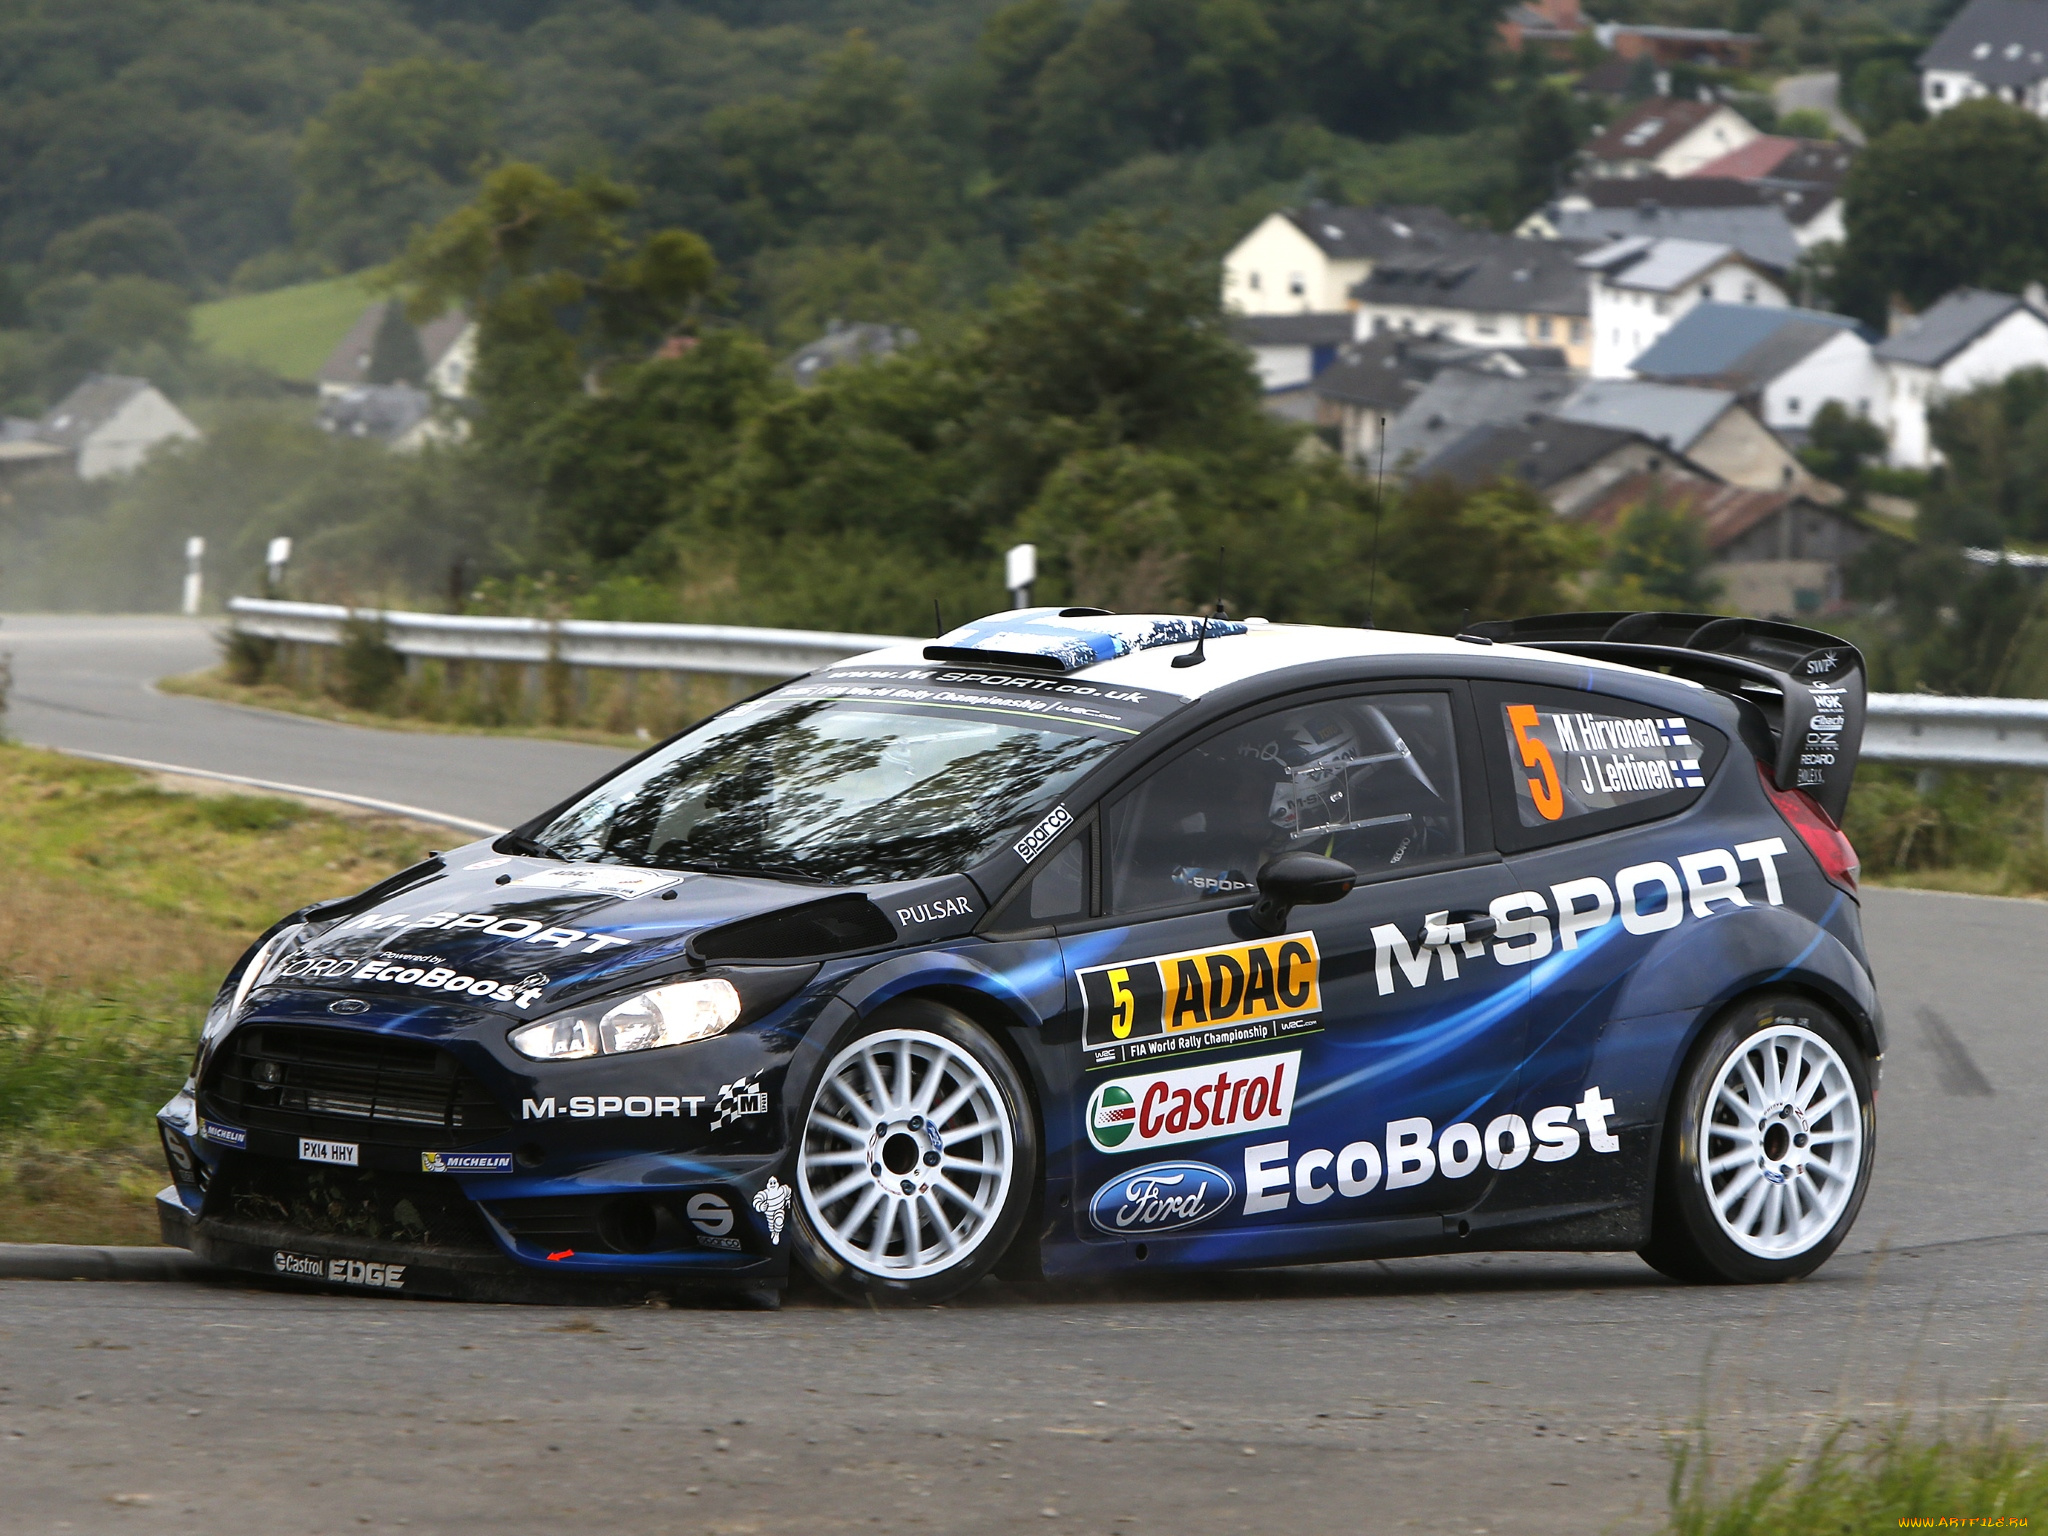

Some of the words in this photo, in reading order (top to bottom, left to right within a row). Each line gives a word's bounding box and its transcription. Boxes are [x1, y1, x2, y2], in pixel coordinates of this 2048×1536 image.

[932, 691, 1049, 712] Championship
[1812, 694, 1843, 708] NGK
[1552, 713, 1580, 752] M
[1574, 712, 1662, 751] Hirvonen
[1505, 704, 1565, 821] 5
[1579, 755, 1595, 795] J
[1591, 752, 1676, 793] Lehtinen
[1800, 753, 1836, 765] RECARO
[1017, 808, 1069, 856] sparco
[896, 896, 974, 926] PULSAR
[1369, 837, 1789, 996] M-SPORT
[340, 912, 633, 955] M-SPORT
[380, 950, 428, 964] Powered
[429, 953, 447, 965] by
[350, 959, 544, 1011] EcoBoost
[1107, 967, 1135, 1040] 5
[1172, 941, 1312, 1028] ADAC
[1130, 1044, 1148, 1058] FIA
[1148, 1038, 1177, 1055] World
[1178, 1035, 1202, 1050] Rally
[1203, 1025, 1269, 1046] Championship
[521, 1095, 707, 1120] M-SPORT
[1138, 1063, 1284, 1140] Castrol
[207, 1125, 246, 1143] MICHELIN
[303, 1142, 328, 1159] PX14
[331, 1145, 354, 1162] HHY
[1242, 1086, 1621, 1216] EcoBoost
[446, 1157, 511, 1168] MICHELIN
[1115, 1174, 1209, 1226] Ford
[285, 1255, 324, 1276] Castrol
[327, 1259, 407, 1289] EDGE
